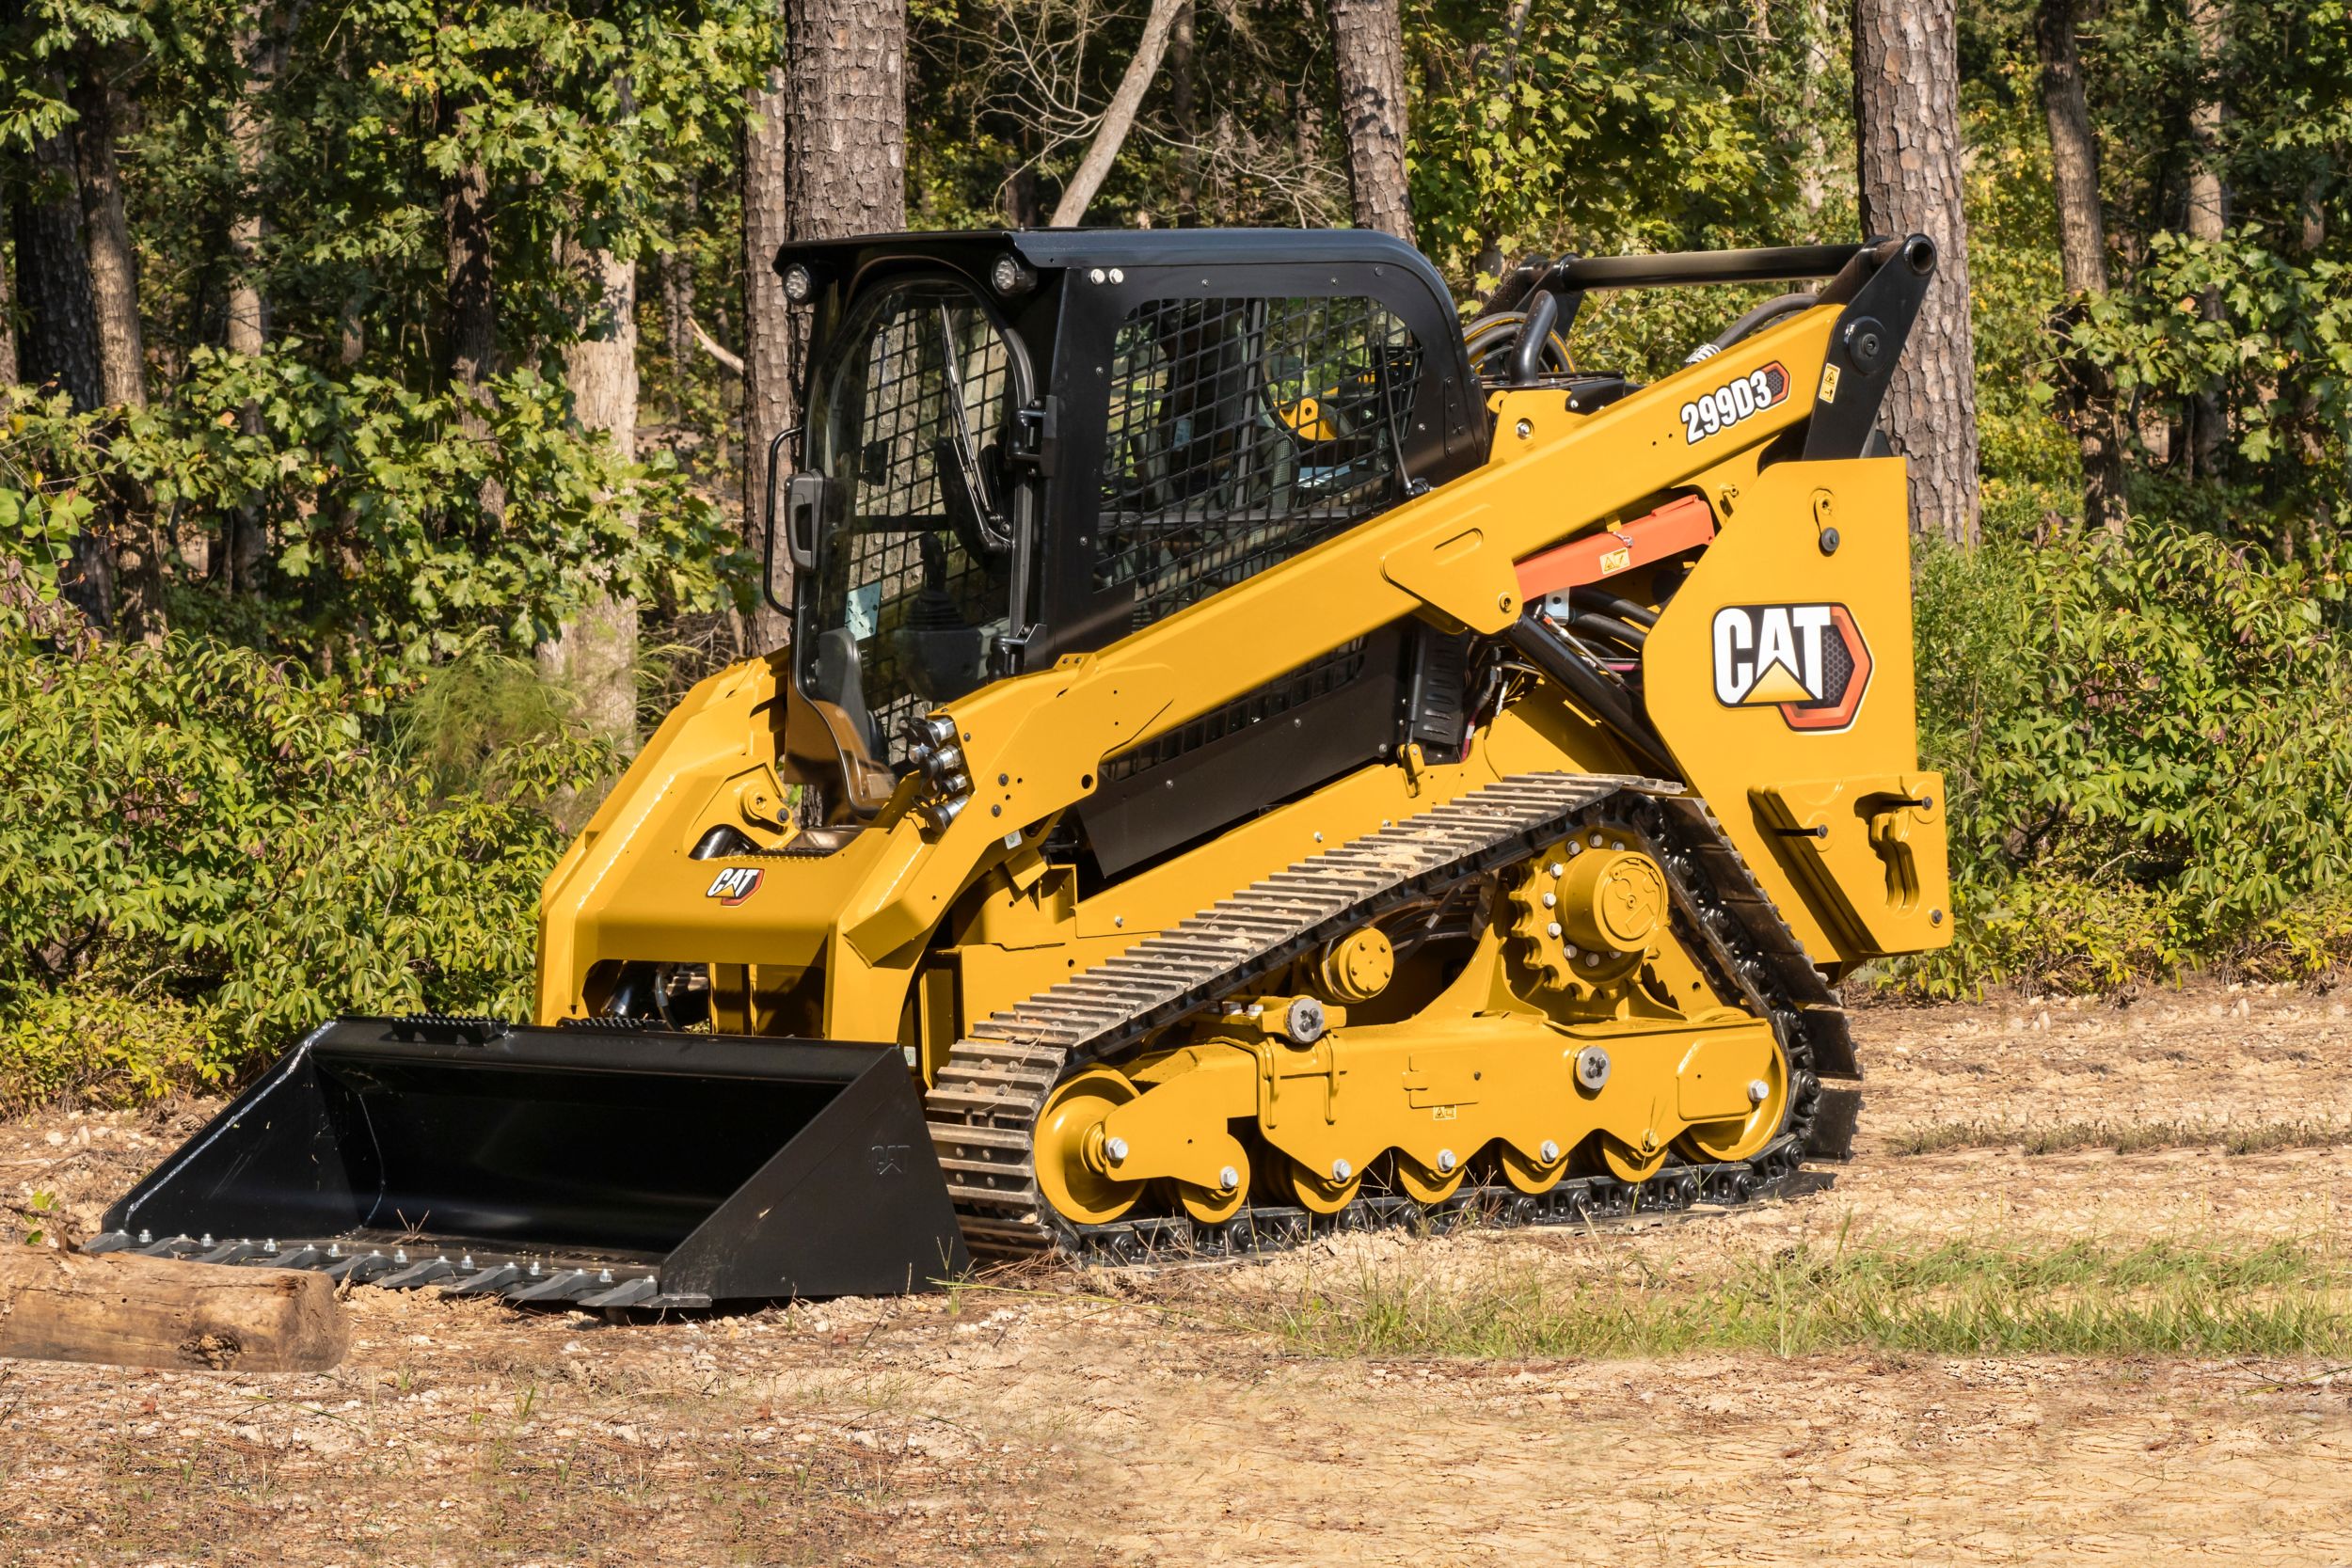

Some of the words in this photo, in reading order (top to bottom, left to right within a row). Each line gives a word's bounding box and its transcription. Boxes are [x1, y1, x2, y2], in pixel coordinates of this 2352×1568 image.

[1681, 370, 1772, 444] 299D3
[1713, 606, 1832, 705] CAT
[707, 867, 760, 897] CAT
